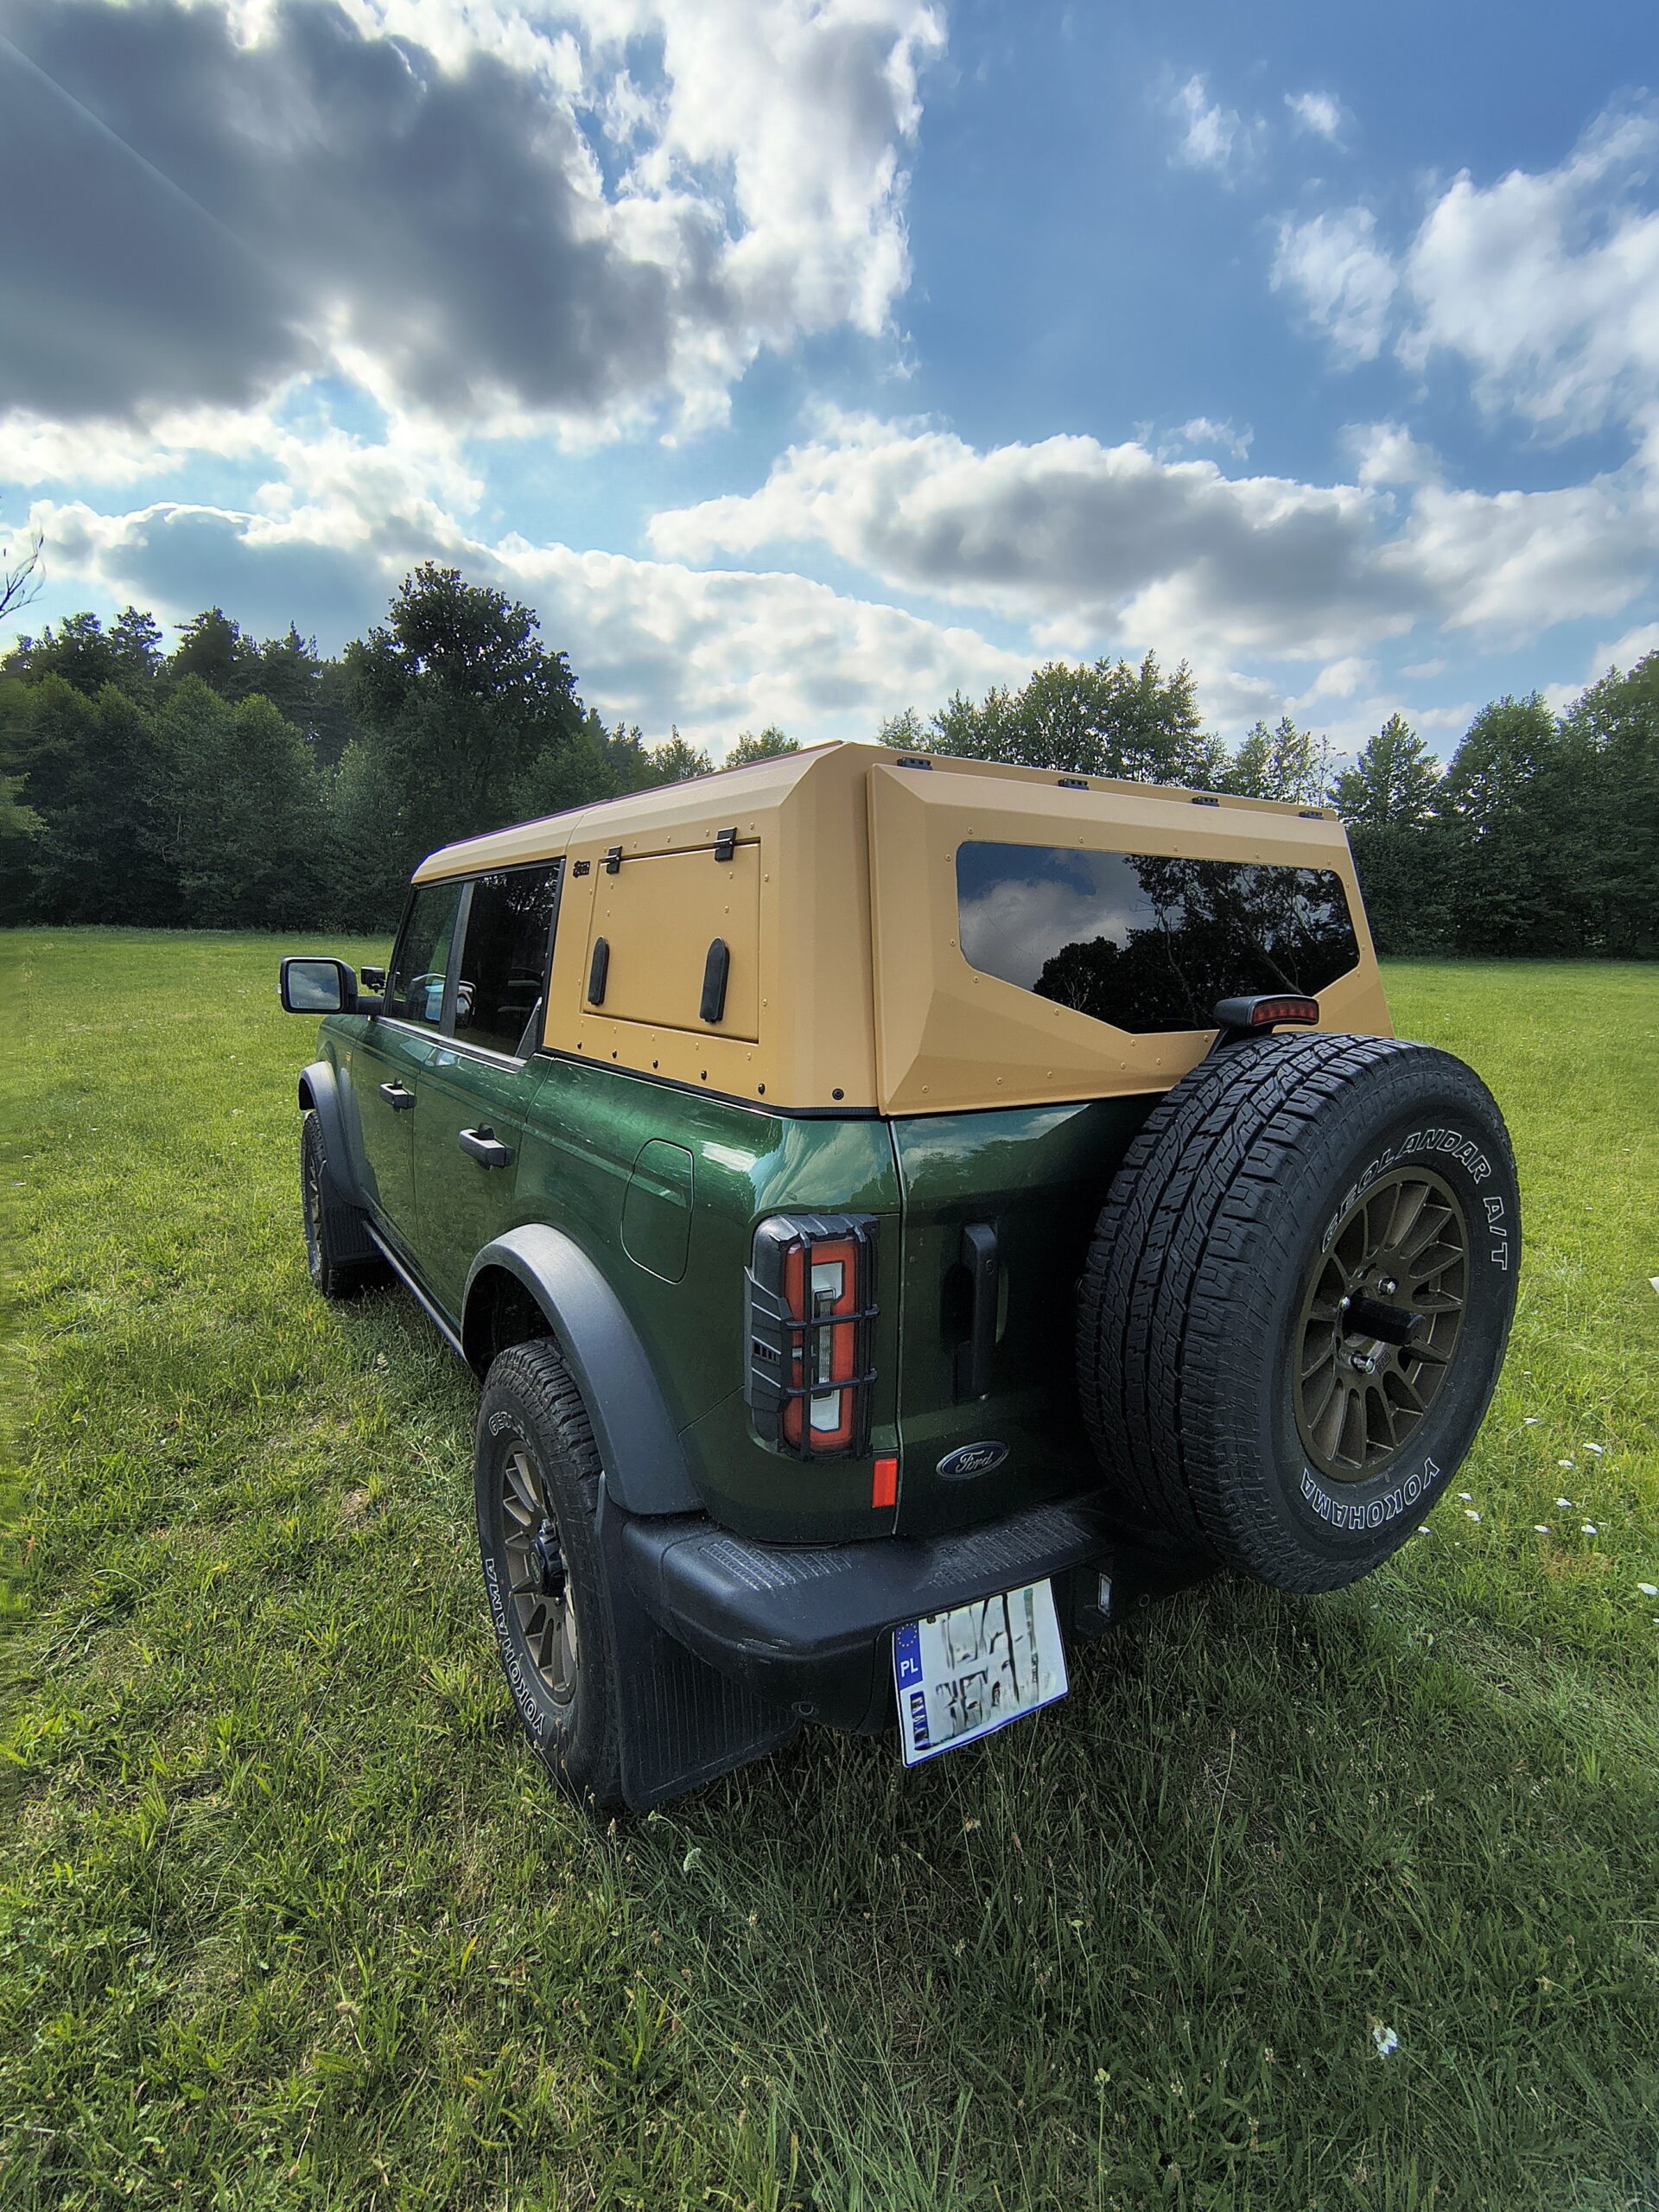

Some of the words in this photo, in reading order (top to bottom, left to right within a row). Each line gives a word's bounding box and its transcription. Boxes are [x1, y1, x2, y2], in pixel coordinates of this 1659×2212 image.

[1322, 1128, 1492, 1253] GEOLANDAR
[1483, 1196, 1508, 1271] A/T
[955, 1450, 994, 1474] Ford
[1300, 1457, 1440, 1529] YOKOHAMA
[485, 1558, 545, 1736] YOKOHAMA
[899, 1660, 919, 1678] PL
